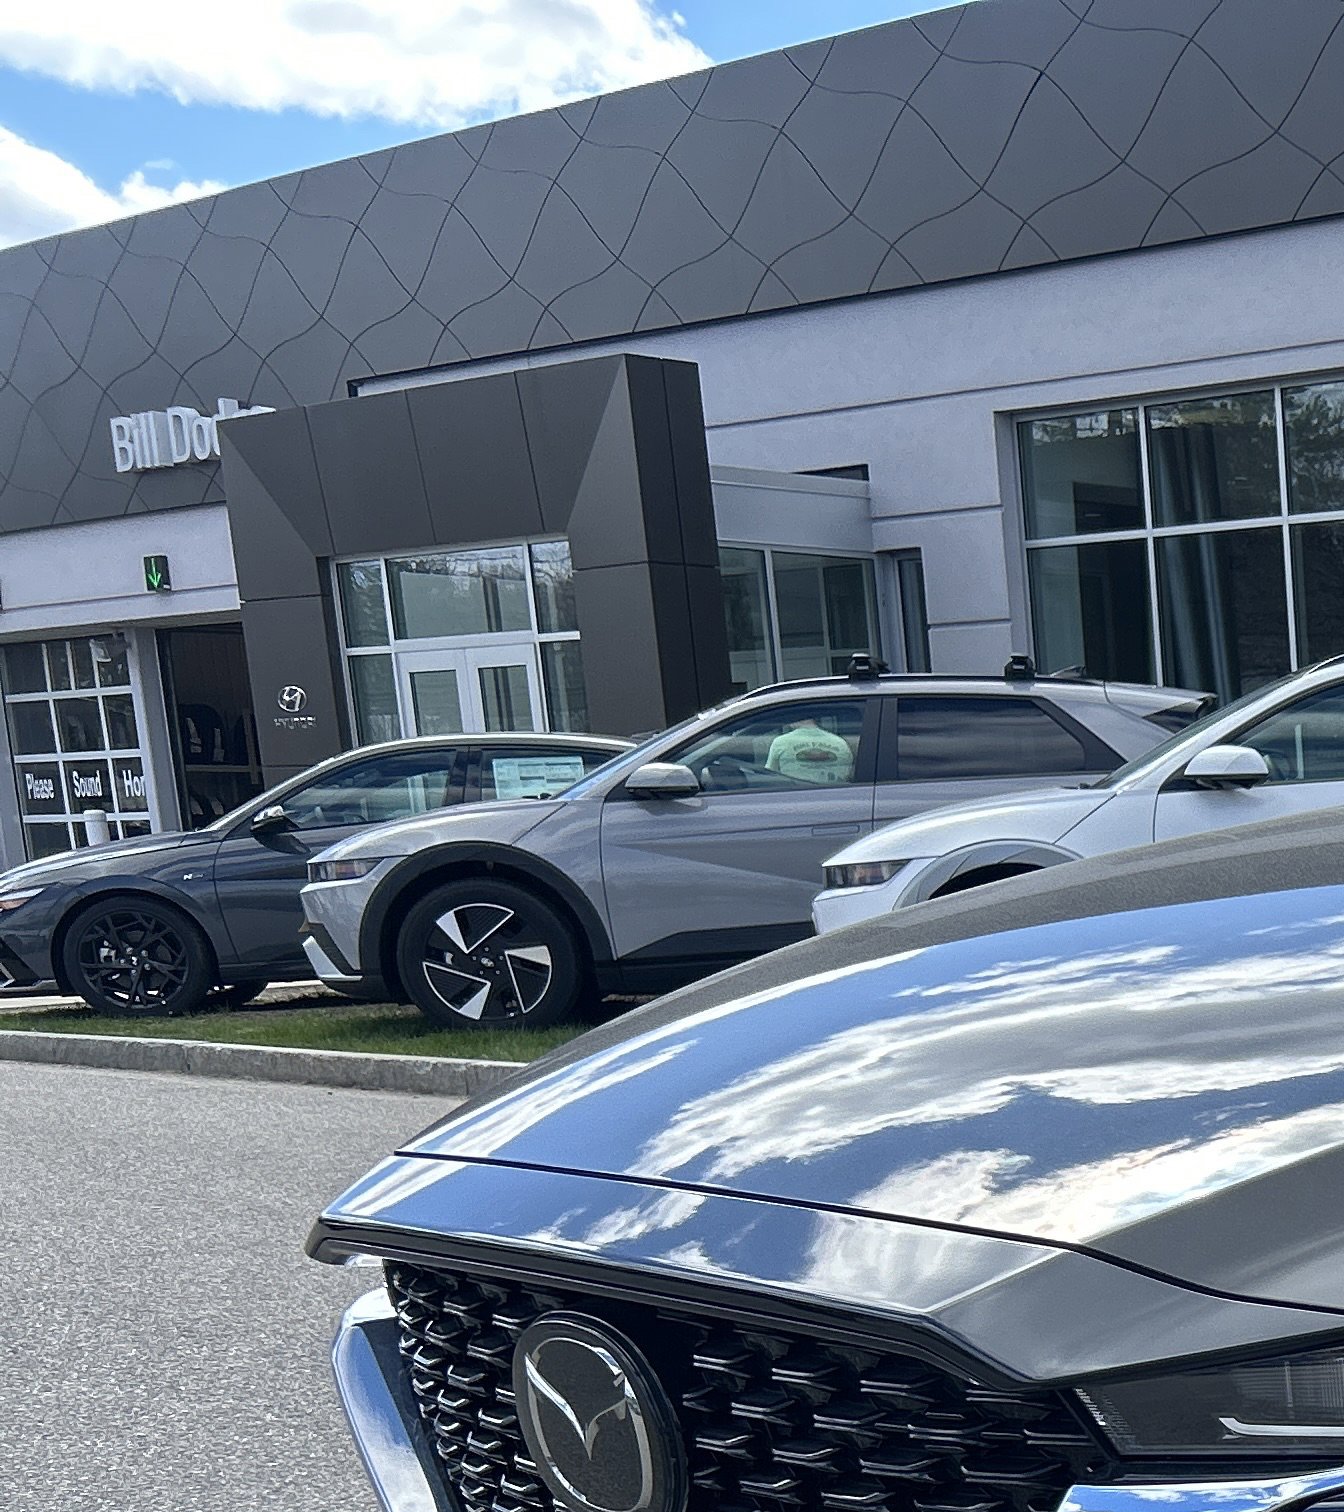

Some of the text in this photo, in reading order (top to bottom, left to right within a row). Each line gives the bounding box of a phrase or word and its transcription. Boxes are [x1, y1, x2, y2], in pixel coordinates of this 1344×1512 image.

[110, 407, 173, 473] Bill
[25, 769, 146, 800] Please Sound Hor
